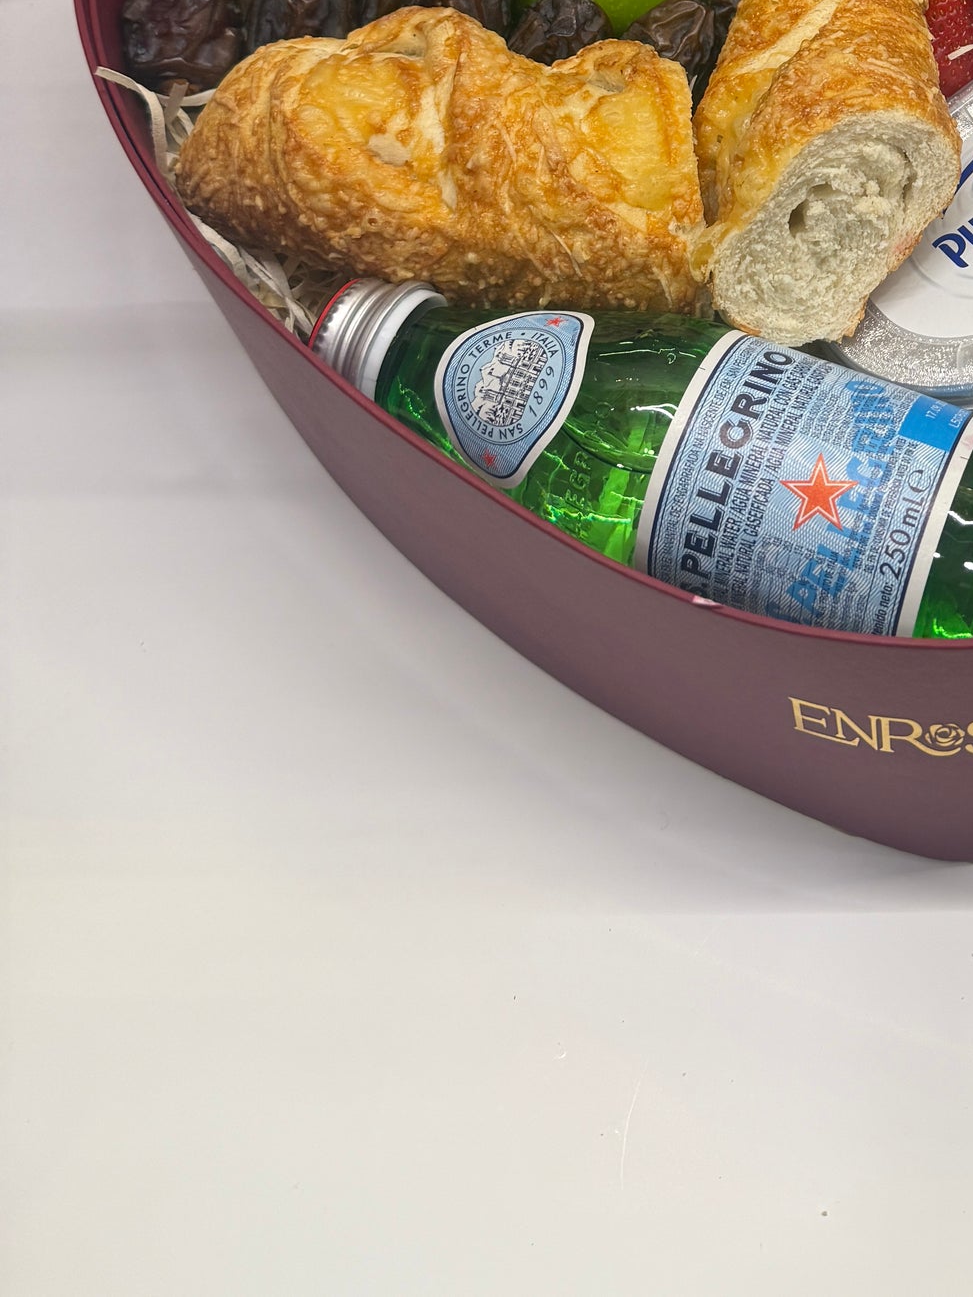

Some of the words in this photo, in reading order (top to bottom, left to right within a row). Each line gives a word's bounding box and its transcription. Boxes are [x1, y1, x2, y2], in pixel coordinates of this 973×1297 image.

[468, 331, 513, 360] TERME
[531, 332, 560, 360] ITALIA
[456, 364, 494, 440] PELLEGRINO
[528, 365, 556, 418] 1899
[500, 422, 524, 440] SAN
[877, 528, 911, 577] 250
[878, 581, 893, 608] neto:
